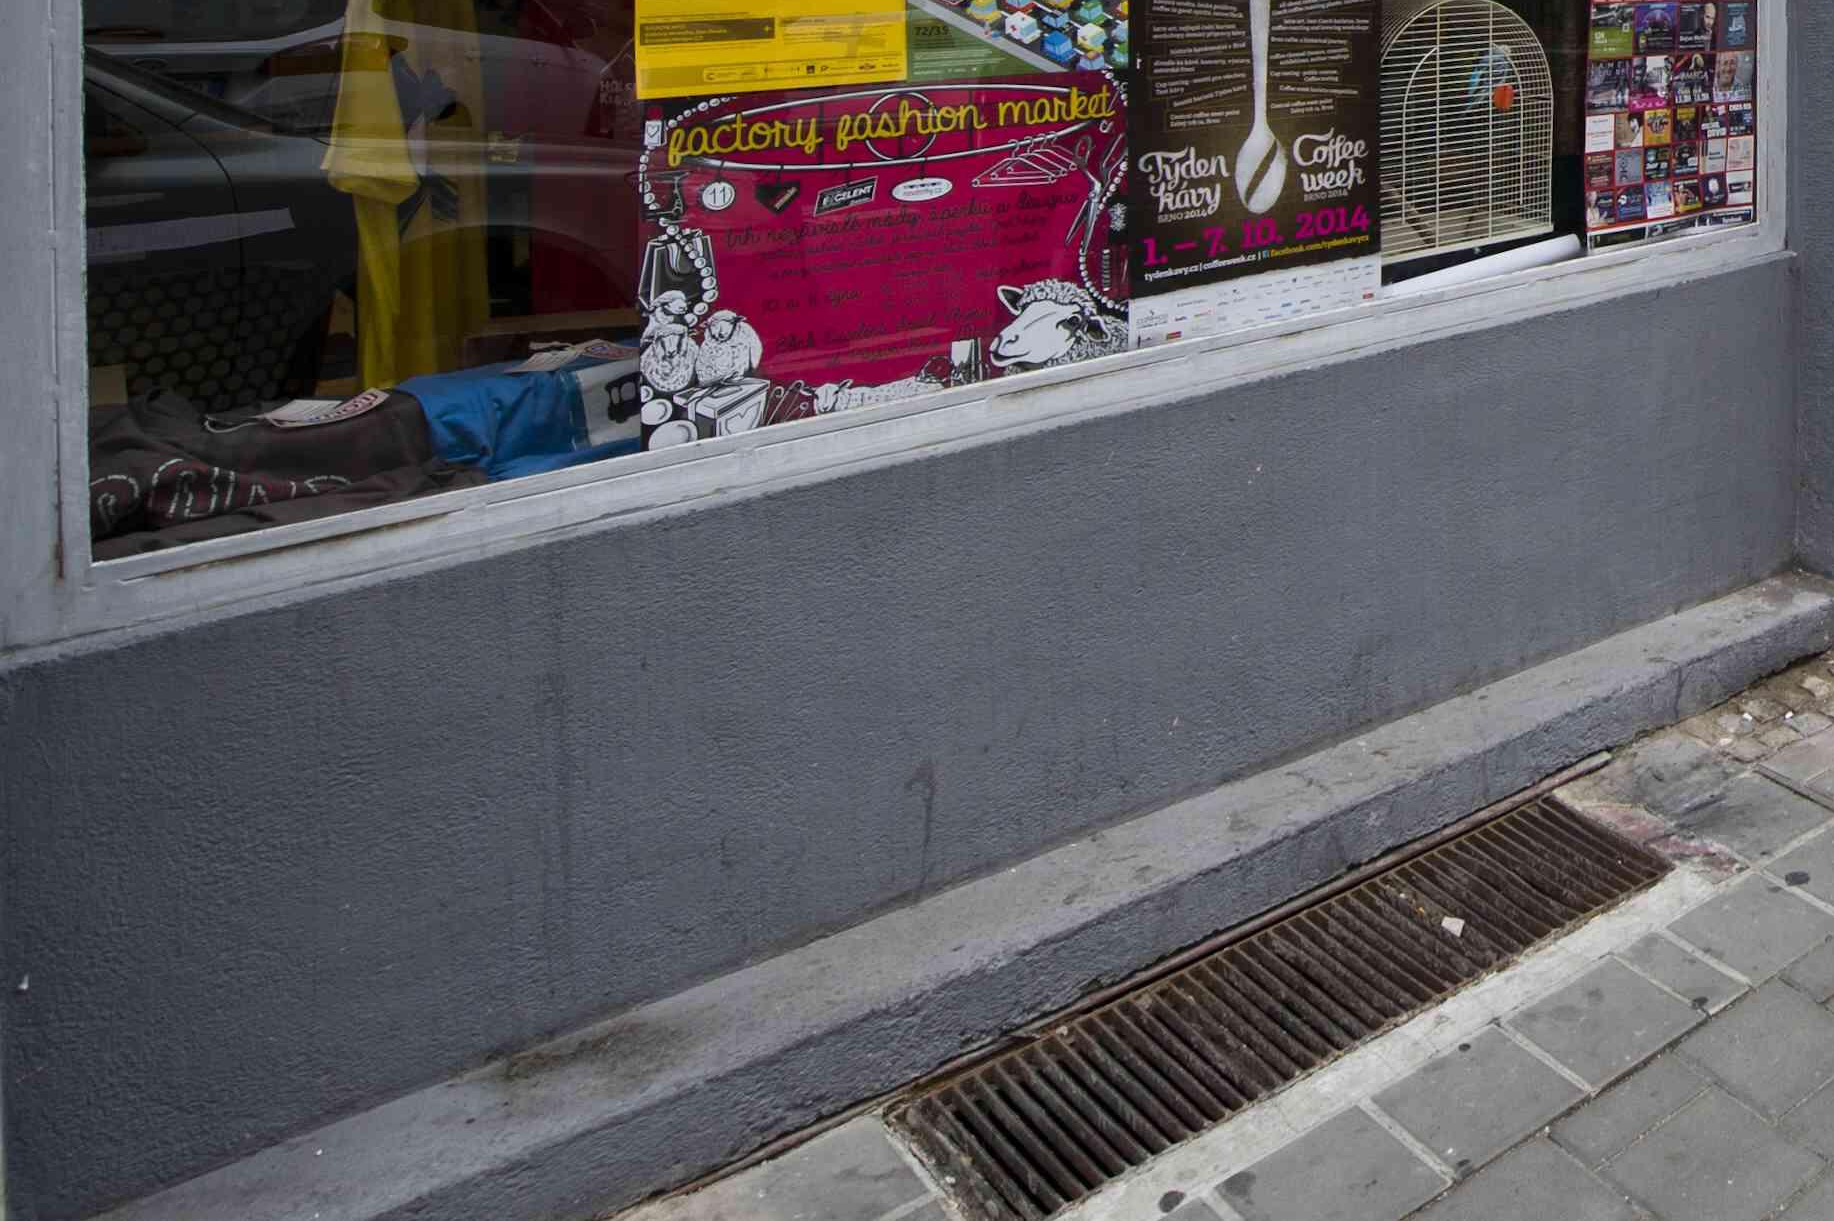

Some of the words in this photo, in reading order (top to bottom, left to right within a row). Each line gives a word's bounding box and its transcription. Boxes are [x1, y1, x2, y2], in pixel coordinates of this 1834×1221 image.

[669, 114, 822, 168] factory
[836, 95, 987, 152] fashion
[998, 86, 1115, 128] market
[1292, 127, 1369, 169] Coffee
[1138, 146, 1230, 190] Týden
[1300, 160, 1365, 193] week
[708, 185, 727, 205] 11
[1150, 179, 1221, 217] kávy
[1143, 237, 1169, 267] 1.
[1240, 217, 1284, 249] 10.
[1295, 204, 1370, 240] 2014
